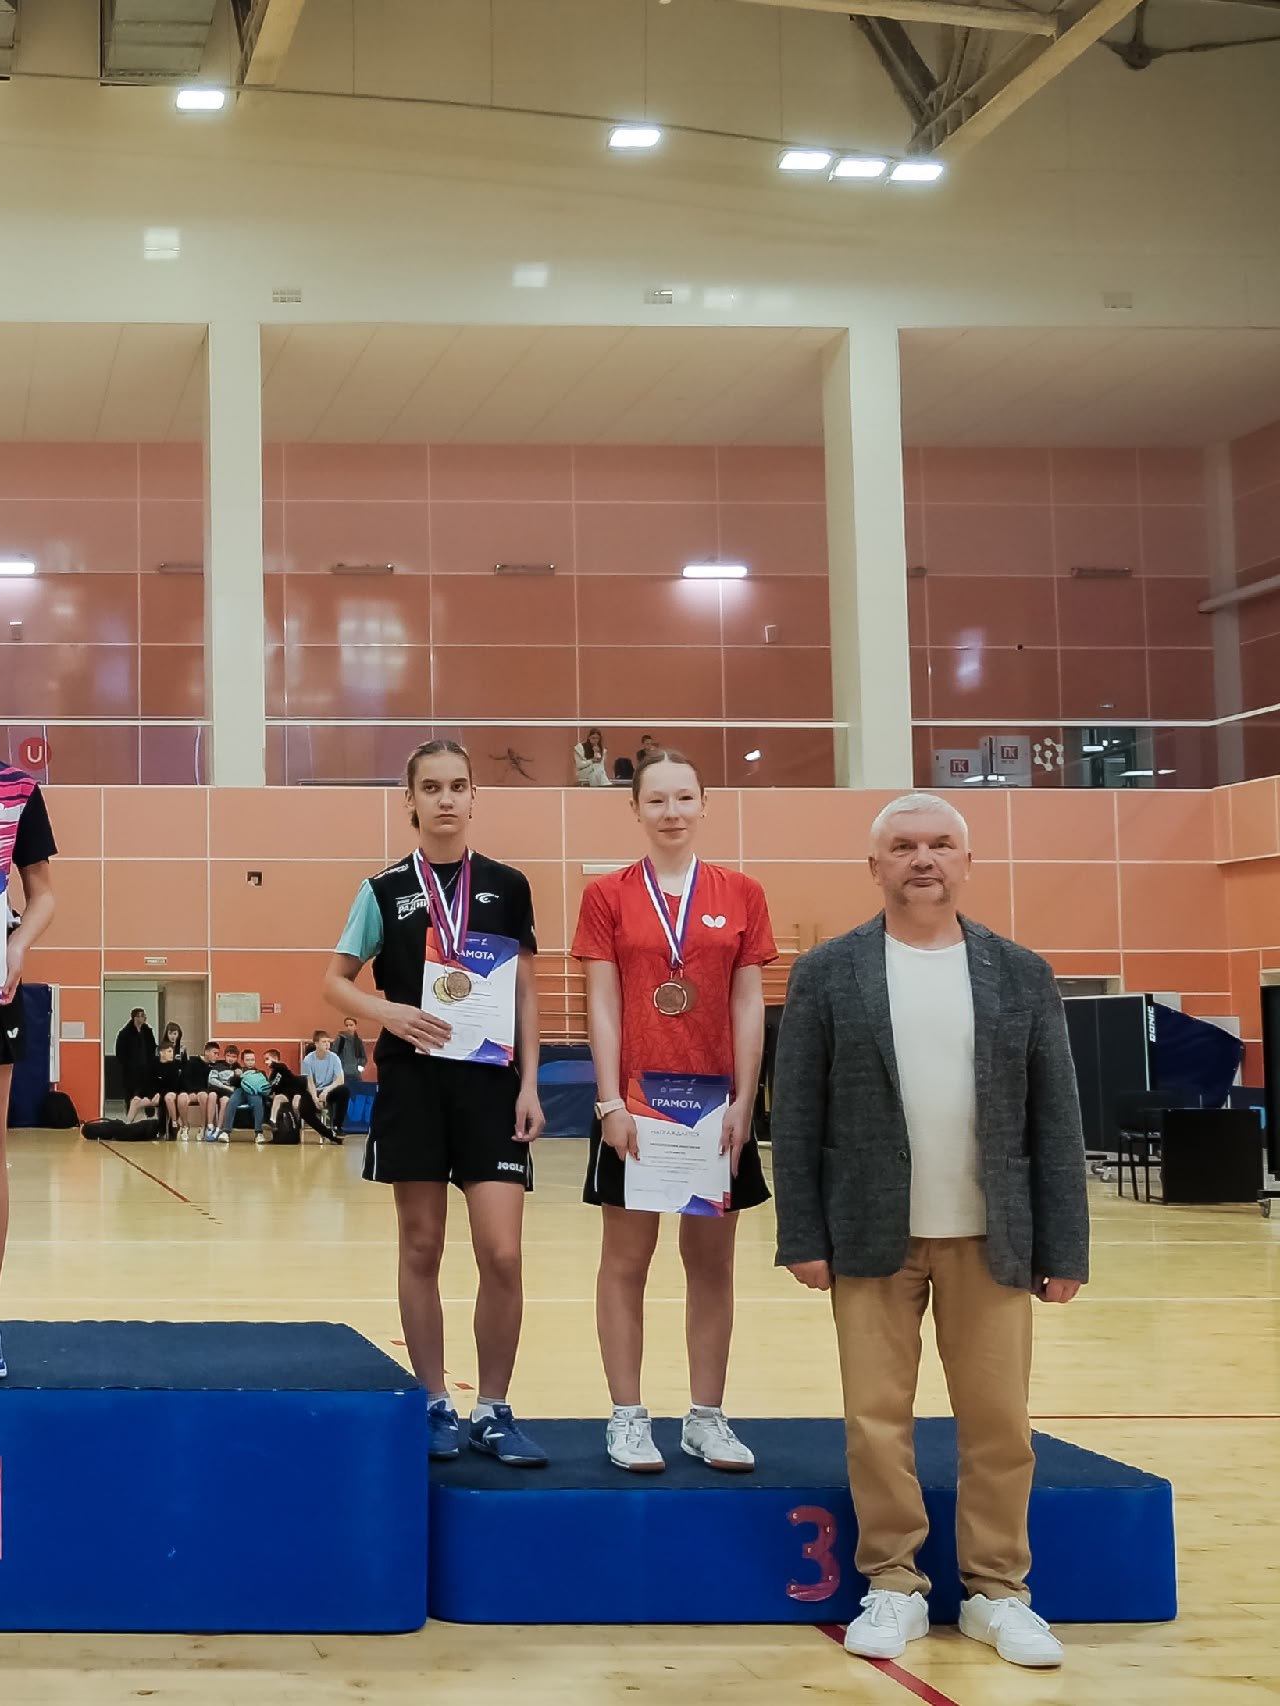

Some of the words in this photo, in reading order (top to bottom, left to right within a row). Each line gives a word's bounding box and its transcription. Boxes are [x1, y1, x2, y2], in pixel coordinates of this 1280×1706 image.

[1003, 746, 1015, 758] ПК
[952, 760, 965, 772] ПК
[459, 949, 495, 961] АМОТА
[1147, 1005, 1156, 1043] DONIC
[651, 1098, 702, 1109] ГРАМОТА
[786, 1505, 840, 1601] 3
